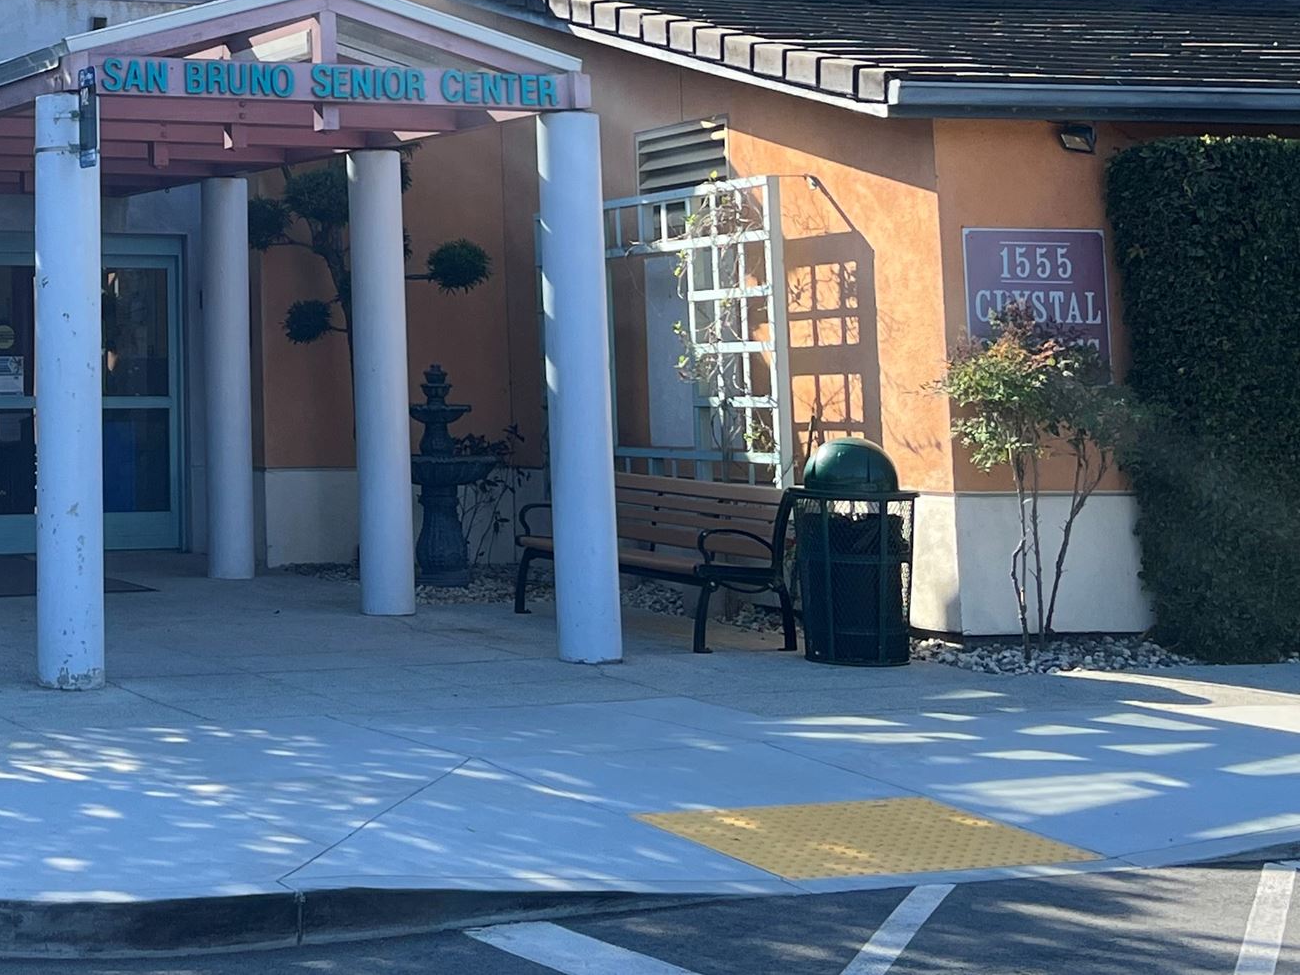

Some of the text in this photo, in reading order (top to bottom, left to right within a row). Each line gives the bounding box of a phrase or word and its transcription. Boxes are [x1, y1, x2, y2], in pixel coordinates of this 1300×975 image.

[102, 58, 559, 106] SAN BRUNO SENIOR CENTER
[1000, 247, 1072, 278] 1555
